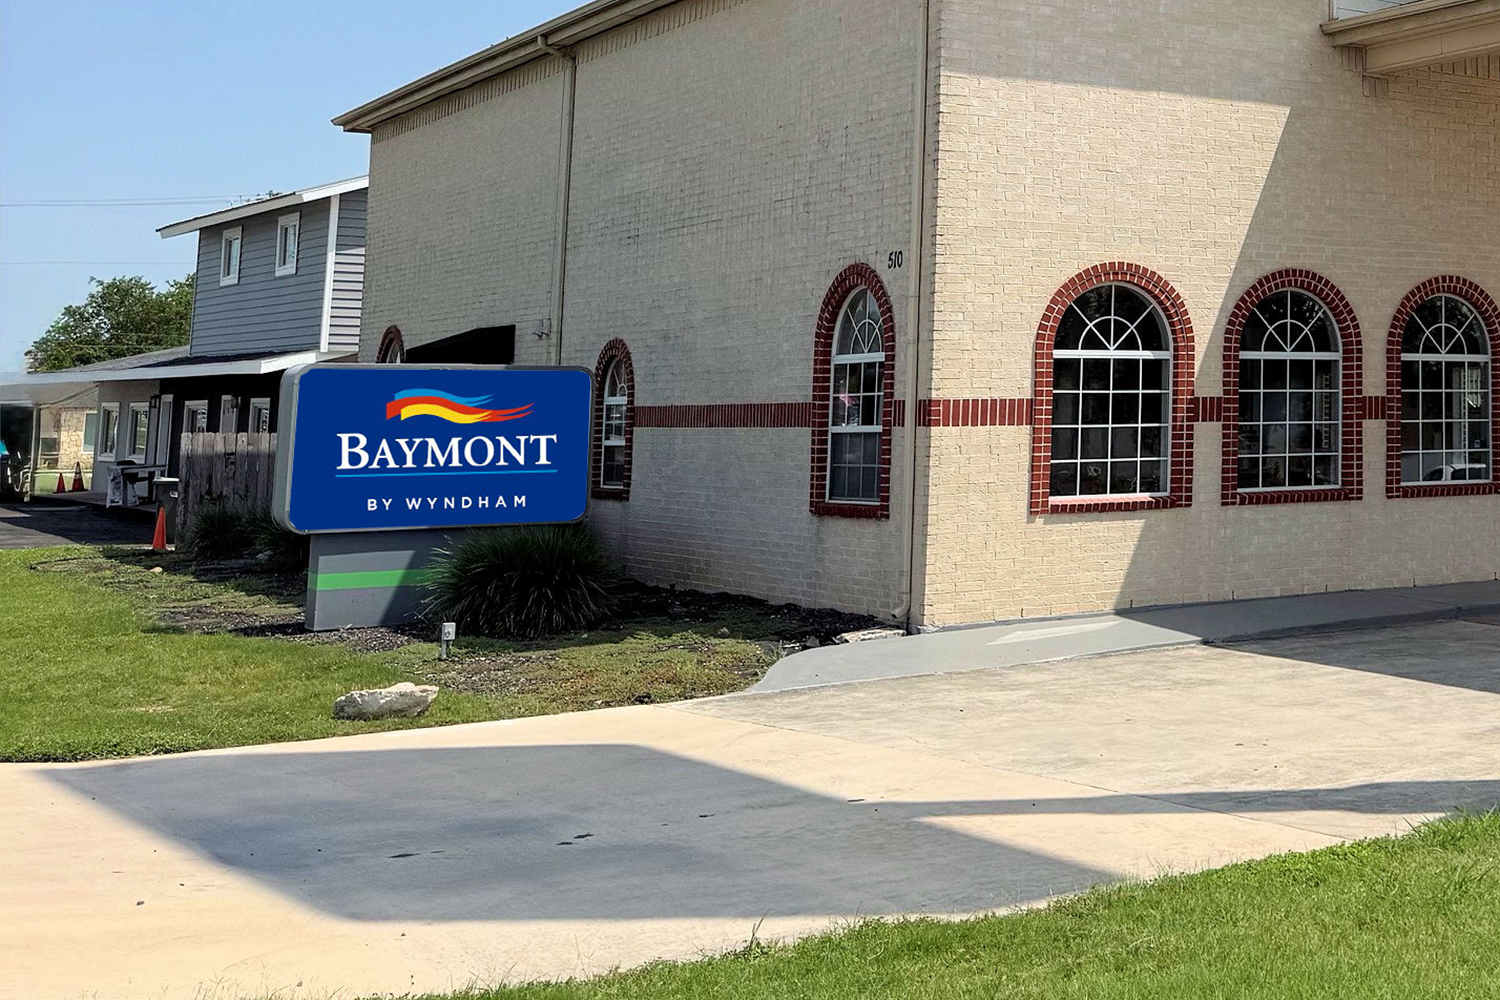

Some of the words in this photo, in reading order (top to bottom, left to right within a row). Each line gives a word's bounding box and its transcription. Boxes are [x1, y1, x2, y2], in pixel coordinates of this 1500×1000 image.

[887, 250, 904, 270] 510
[336, 432, 558, 470] BAYMONT
[367, 498, 393, 511] BY
[405, 495, 527, 510] WYNDHAM
